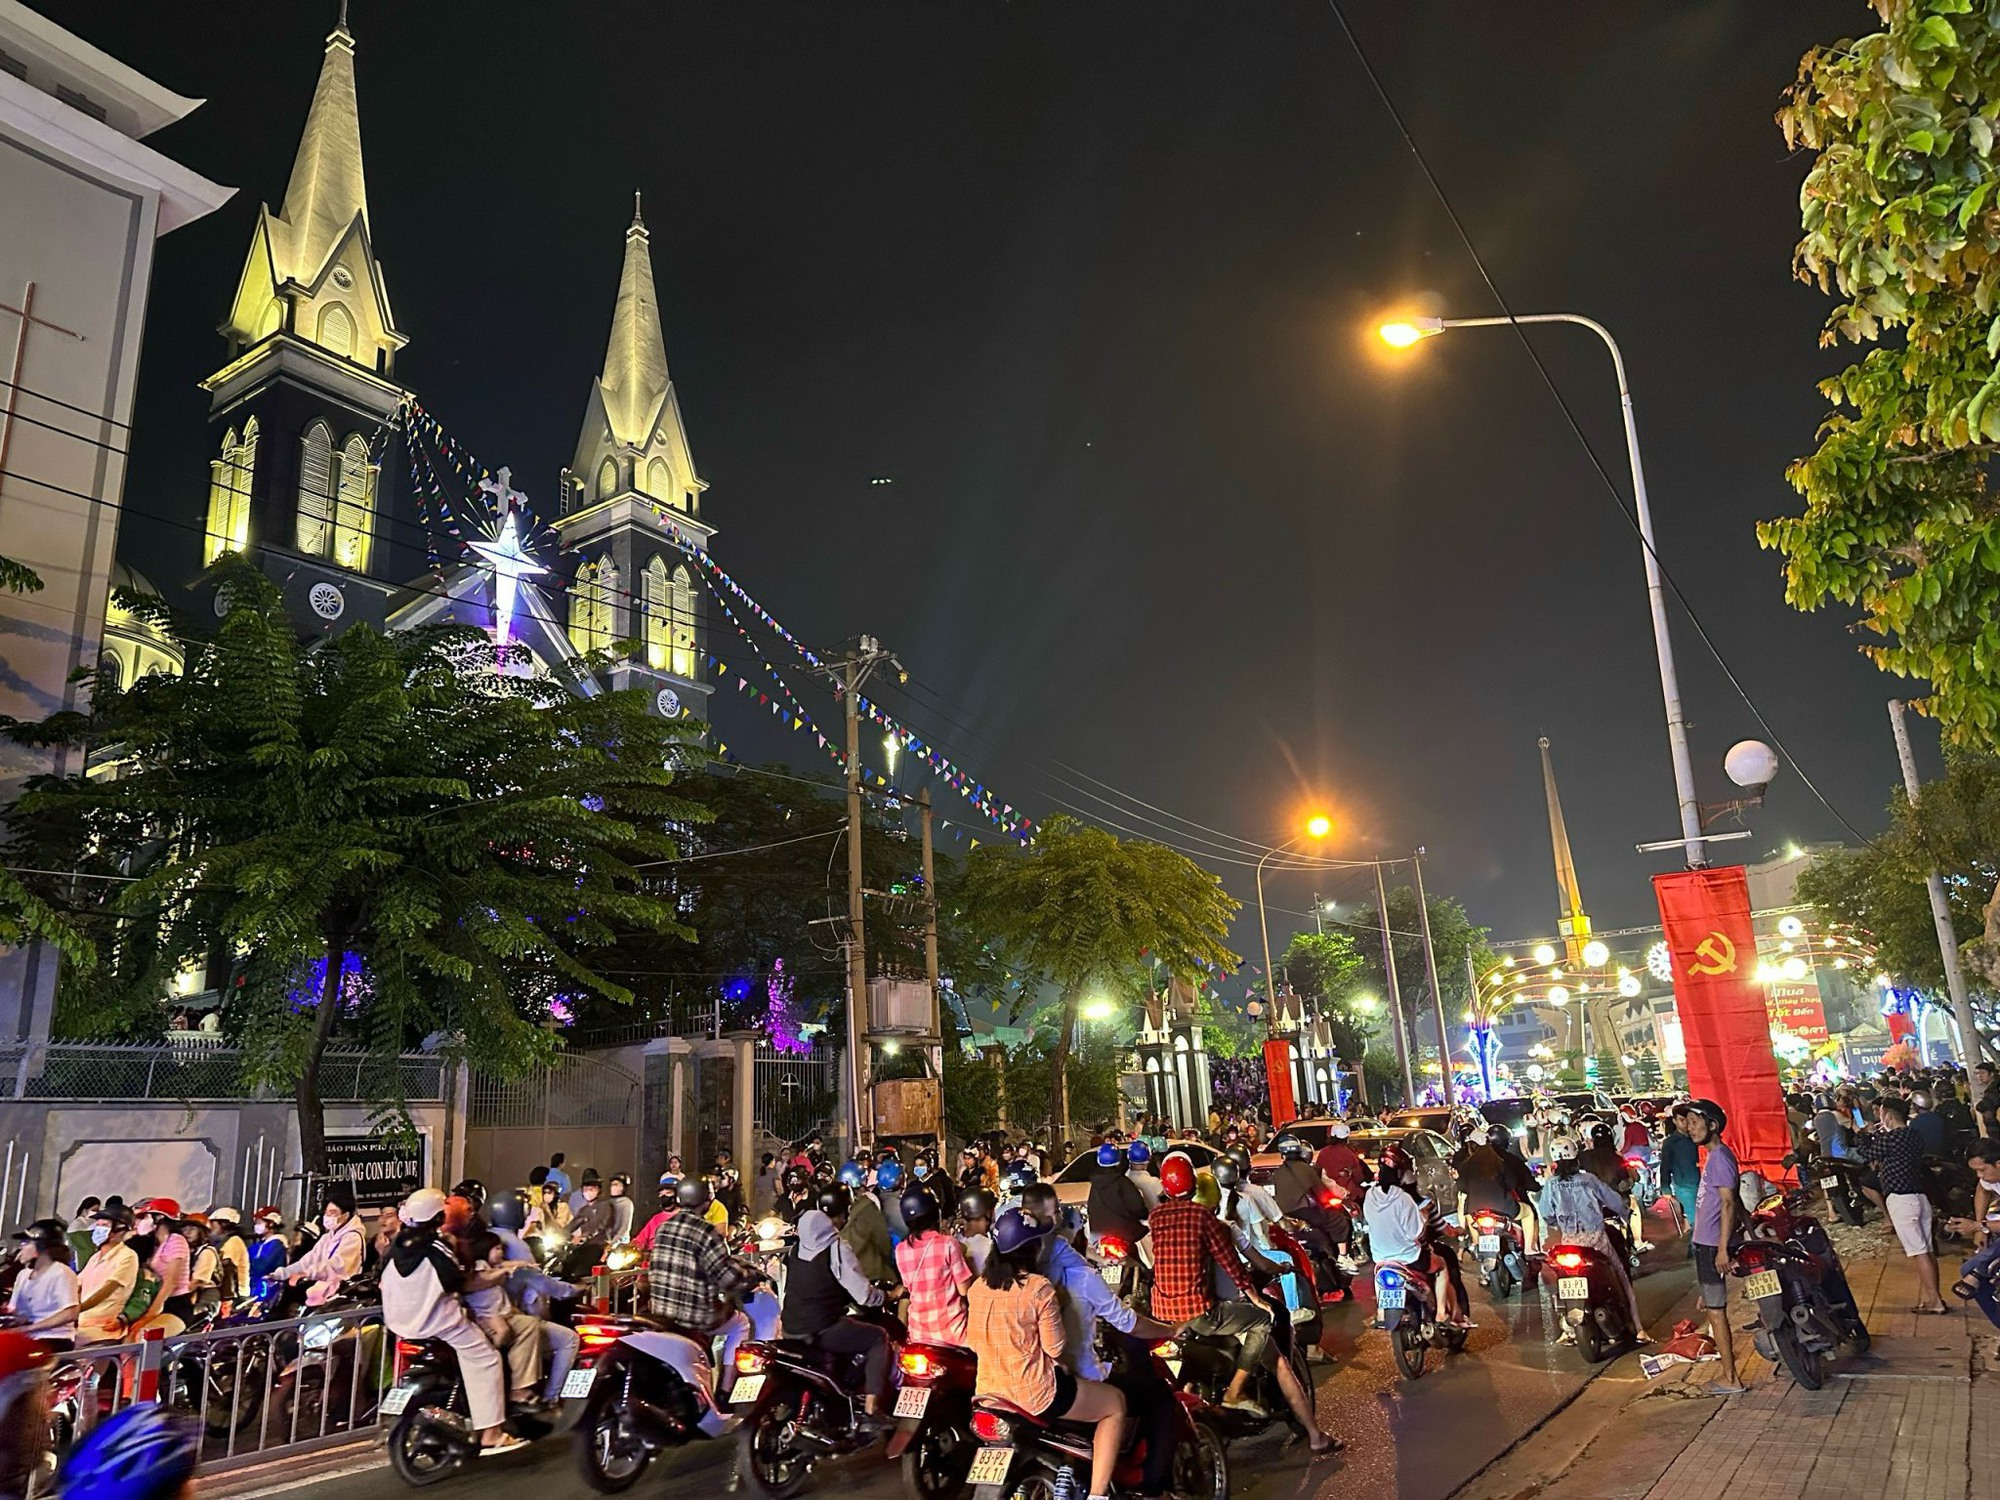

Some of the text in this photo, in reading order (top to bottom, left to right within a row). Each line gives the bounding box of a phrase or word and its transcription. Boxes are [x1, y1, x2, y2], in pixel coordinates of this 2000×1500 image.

[365, 1161, 384, 1180] CON
[385, 1156, 403, 1179] ĐỨC
[903, 1389, 925, 1403] 61-C1
[979, 1450, 1007, 1466] 83-P2
[970, 1466, 1005, 1482] 544.10
